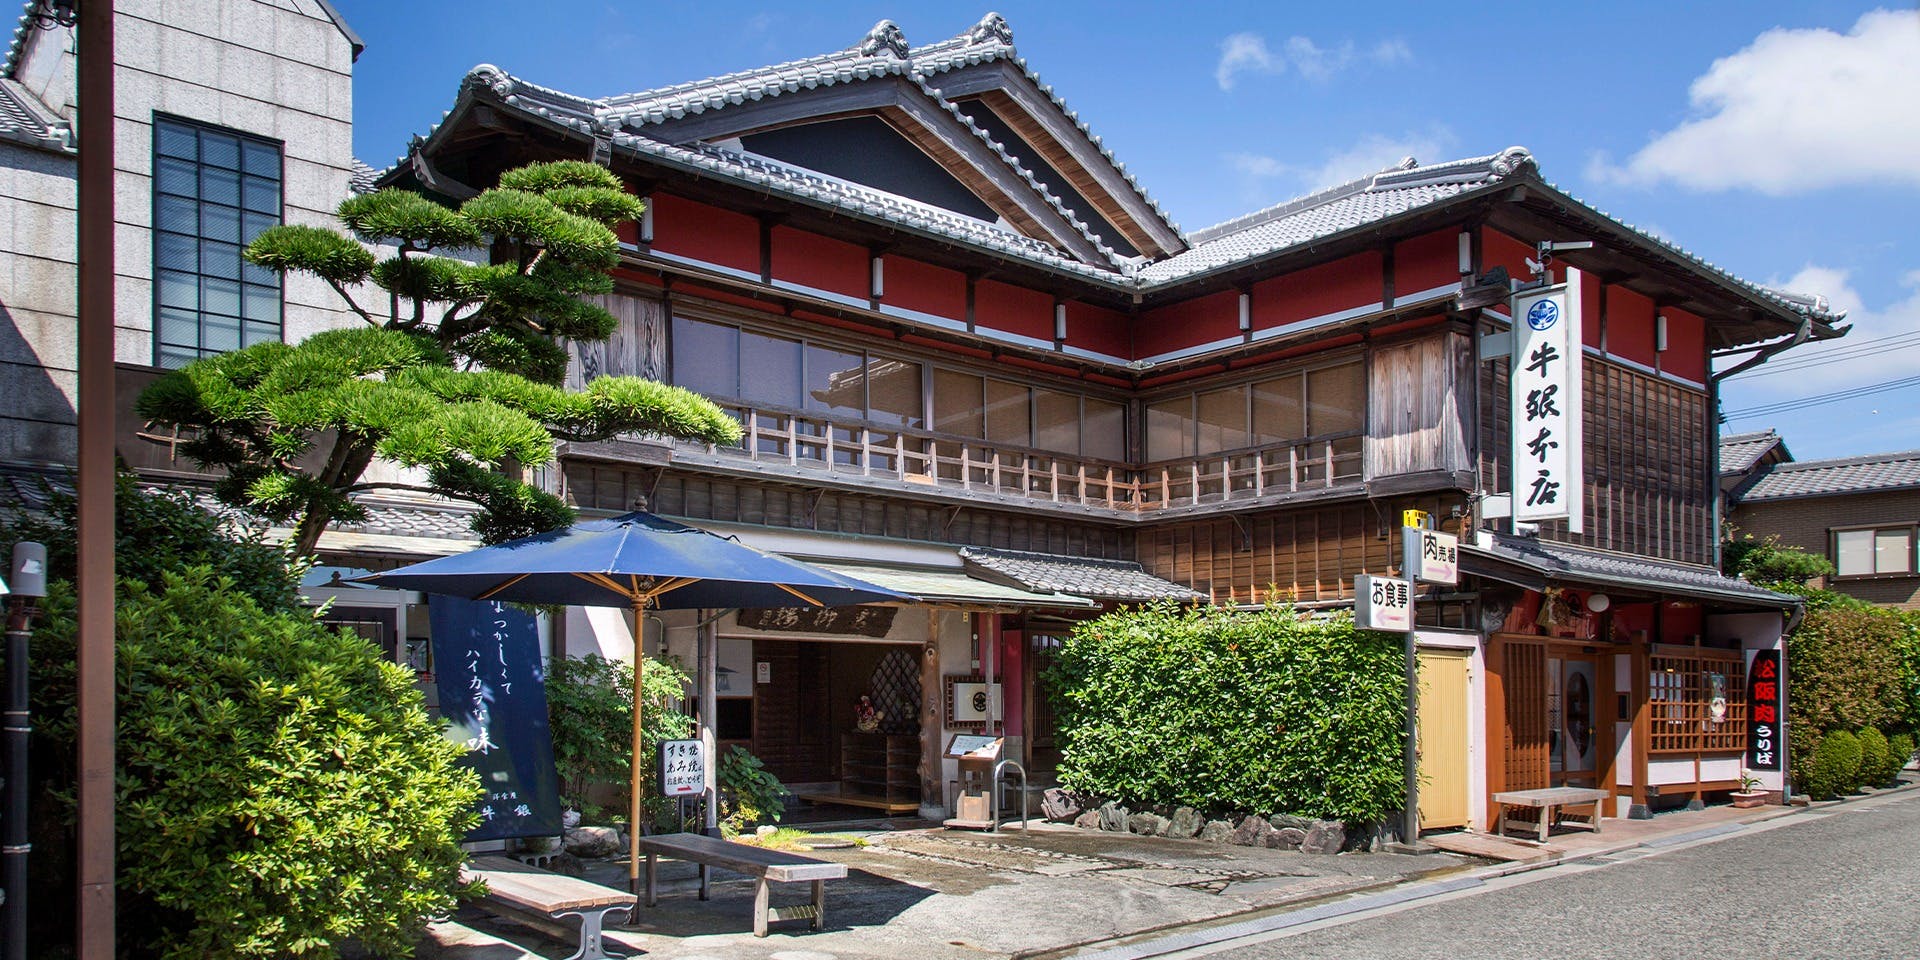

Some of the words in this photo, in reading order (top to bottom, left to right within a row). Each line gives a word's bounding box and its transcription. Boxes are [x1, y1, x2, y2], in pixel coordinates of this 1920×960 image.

[1525, 341, 1560, 507] 牛銀本店
[1373, 580, 1408, 608] お食事
[1424, 533, 1455, 563] 肉売場
[466, 650, 499, 755] ハイカラな味
[1754, 659, 1776, 765] 松阪肉うりば
